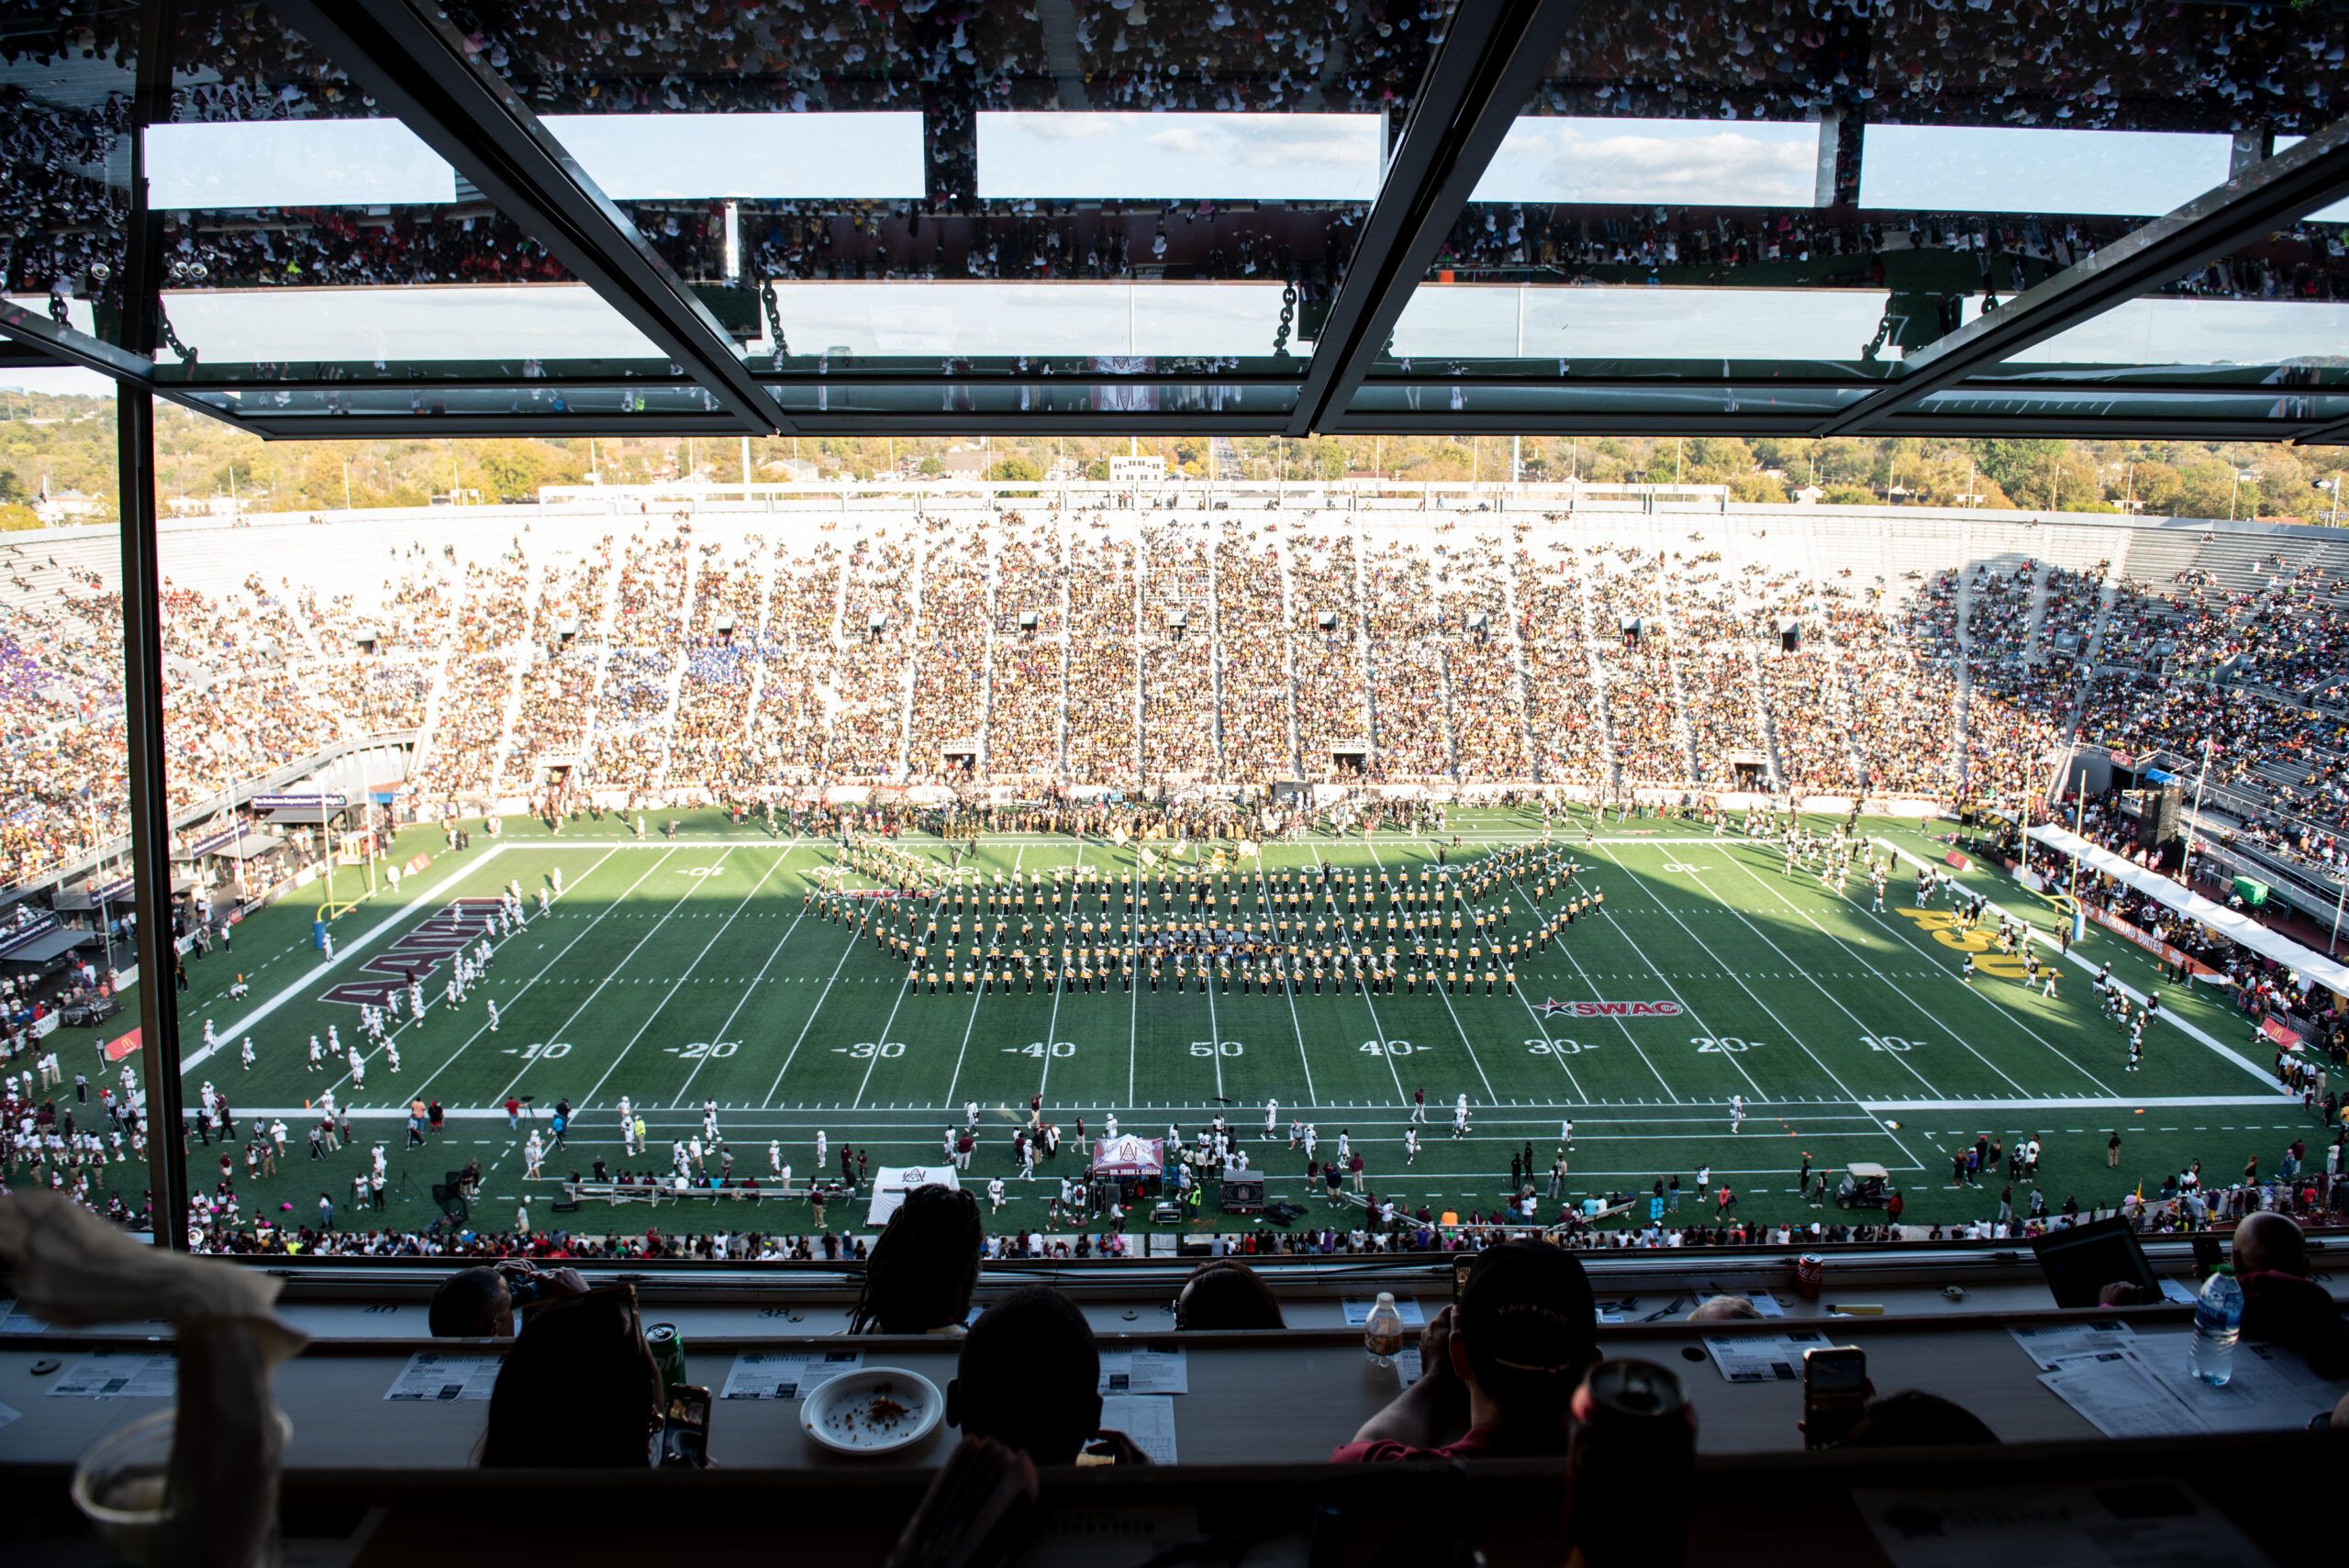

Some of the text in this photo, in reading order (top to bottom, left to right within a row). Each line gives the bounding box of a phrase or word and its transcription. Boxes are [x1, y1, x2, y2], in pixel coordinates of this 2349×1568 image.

[2098, 908, 2136, 940] BACKYARD
[2137, 929, 2164, 955] SUITES
[1894, 907, 2065, 978] ASU
[1571, 1000, 1683, 1018] SWAC
[519, 1042, 573, 1059] 10
[678, 1042, 740, 1058] 20
[850, 1042, 906, 1058] 30
[1021, 1042, 1075, 1057] 40
[1189, 1041, 1243, 1057] 50
[1359, 1040, 1413, 1056] 40
[1523, 1039, 1581, 1054] 30
[1689, 1037, 1749, 1052] 20
[1858, 1036, 1912, 1051] 10
[758, 1307, 791, 1318] 38
